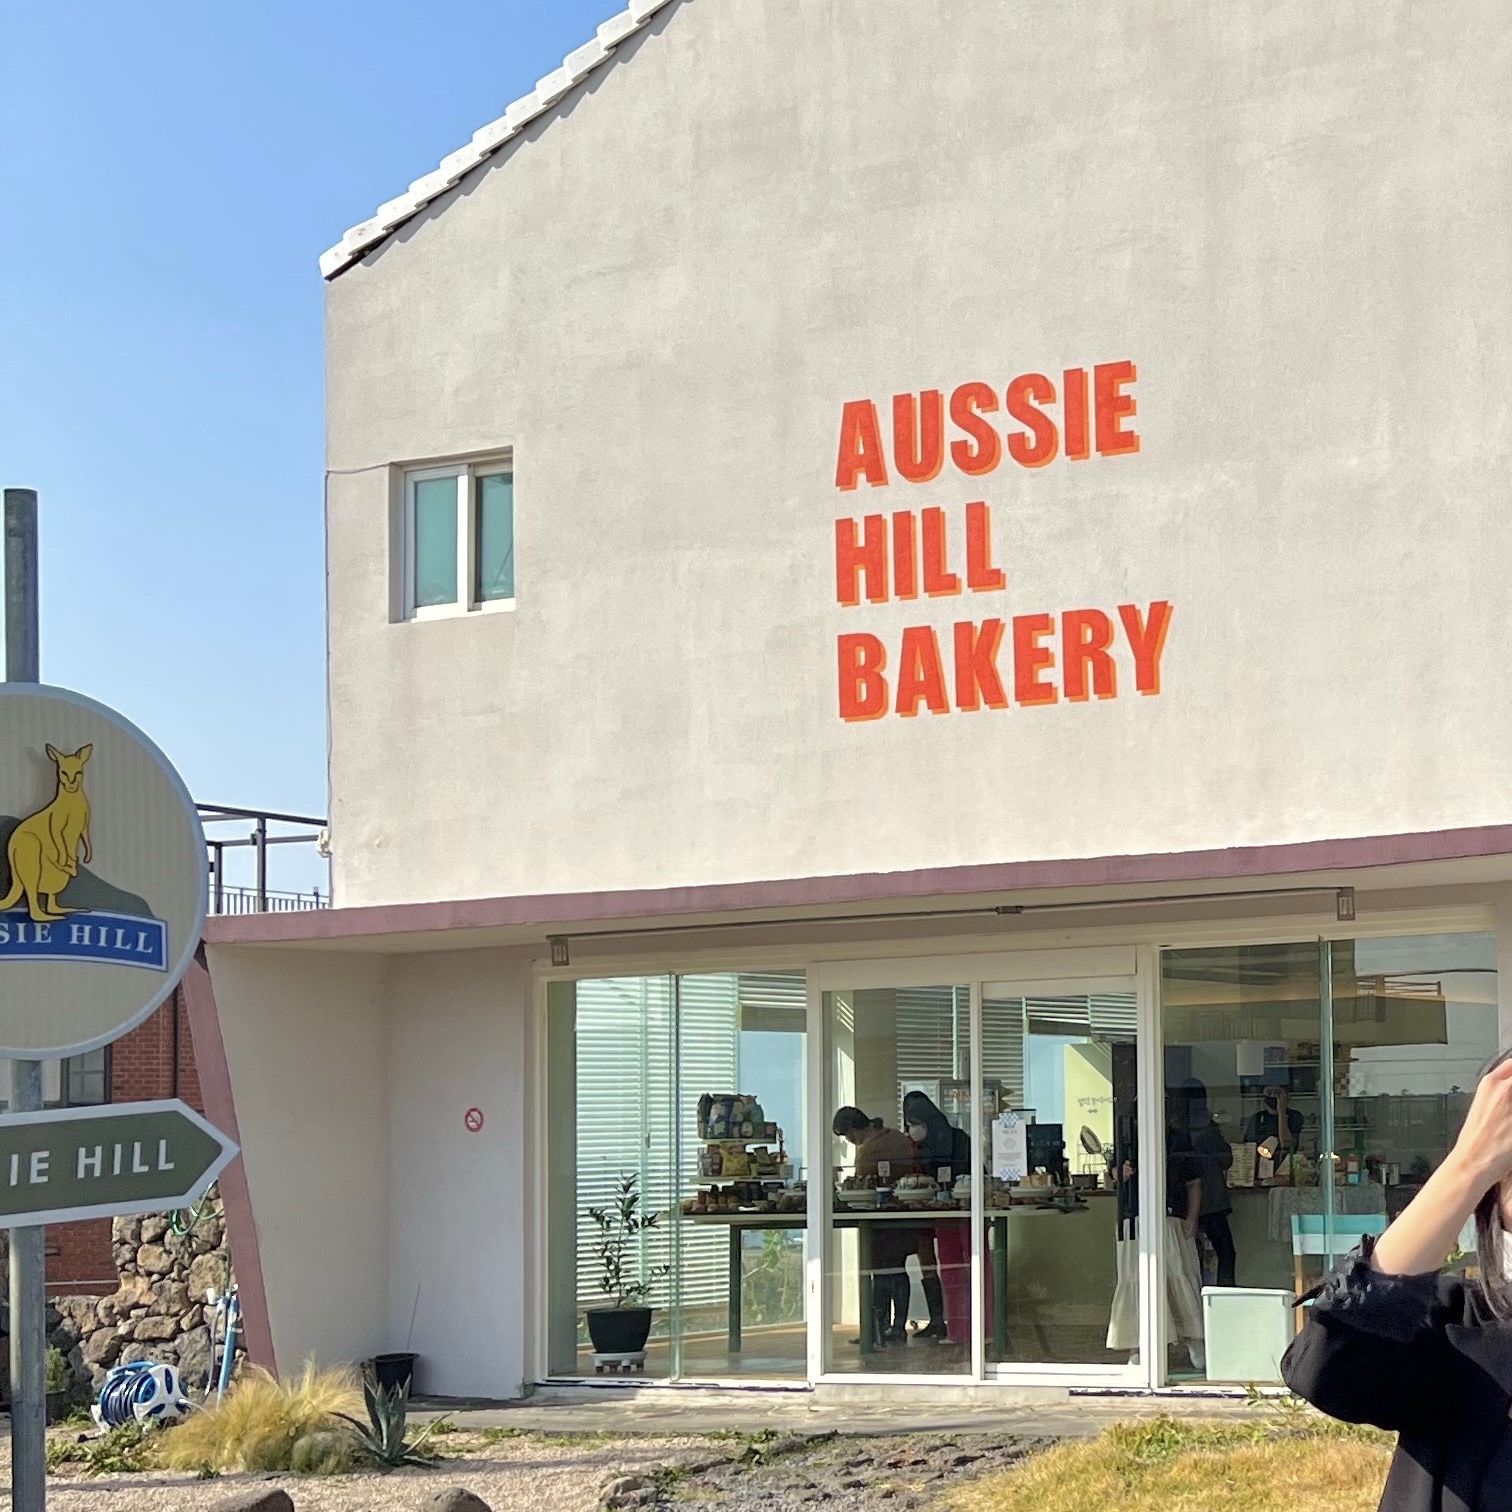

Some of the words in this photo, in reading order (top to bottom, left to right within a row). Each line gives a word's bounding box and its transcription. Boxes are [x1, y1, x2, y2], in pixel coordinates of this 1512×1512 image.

[835, 360, 1140, 492] AUSSIE
[835, 501, 1007, 607] HILL
[837, 600, 1173, 723] BAKERY
[69, 923, 153, 953] HILL
[77, 1139, 175, 1179] HILL
